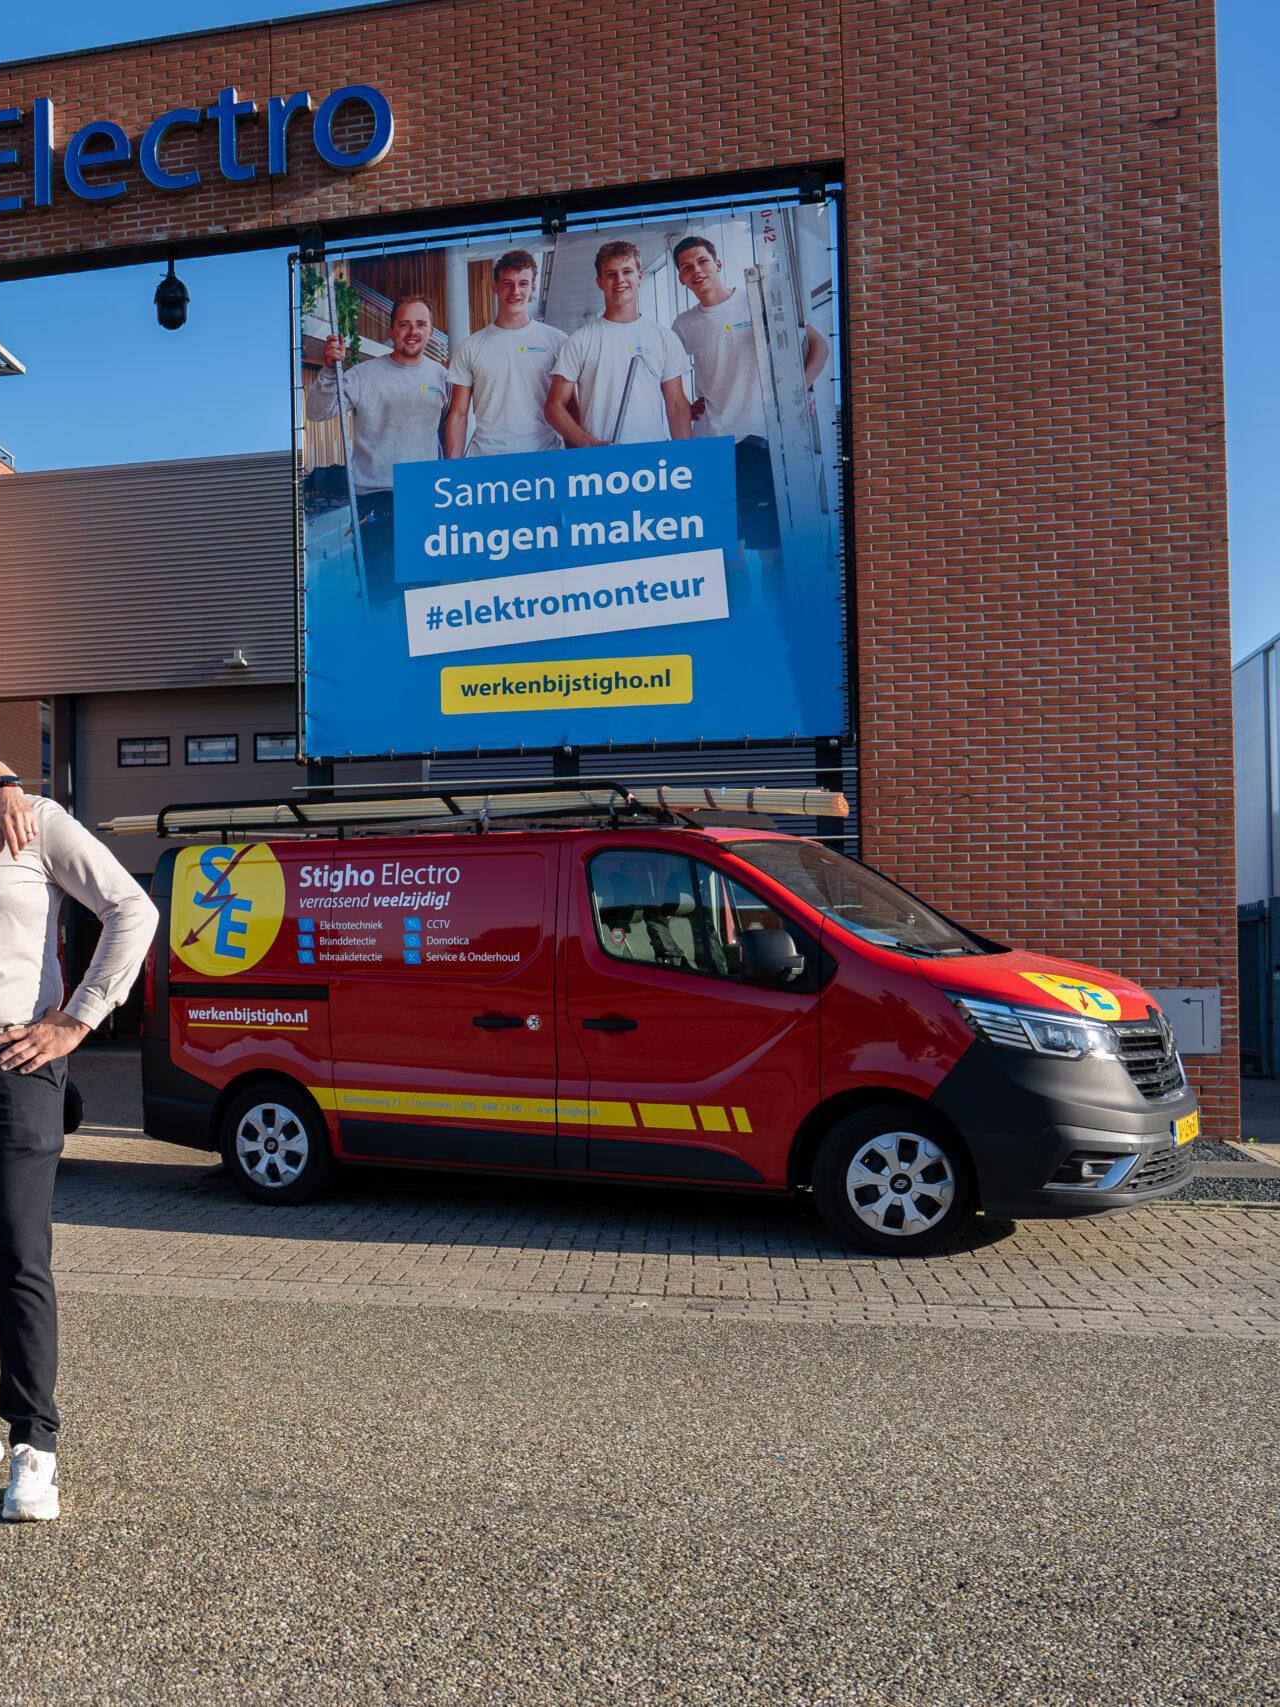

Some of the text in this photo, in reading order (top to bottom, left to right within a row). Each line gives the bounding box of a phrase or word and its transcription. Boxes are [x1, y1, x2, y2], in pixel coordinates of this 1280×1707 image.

[433, 459, 694, 509] Samen mooie
[423, 510, 705, 562] dingen maken
[426, 575, 706, 631] #elektromonteur
[460, 668, 672, 699] werkenbijstigho.nl
[299, 862, 461, 893] Stigho Electro
[299, 891, 452, 911] verrassend veelzijdig!
[319, 920, 384, 930] Elektrotechniek
[426, 919, 451, 929] CCTV
[319, 937, 377, 946] Branddetectie
[426, 936, 469, 946] Domotica
[319, 952, 383, 962] Inbraakdetectie
[426, 952, 521, 963] Service & Onderhoud
[188, 1007, 308, 1024] werkenbijstigho.nl
